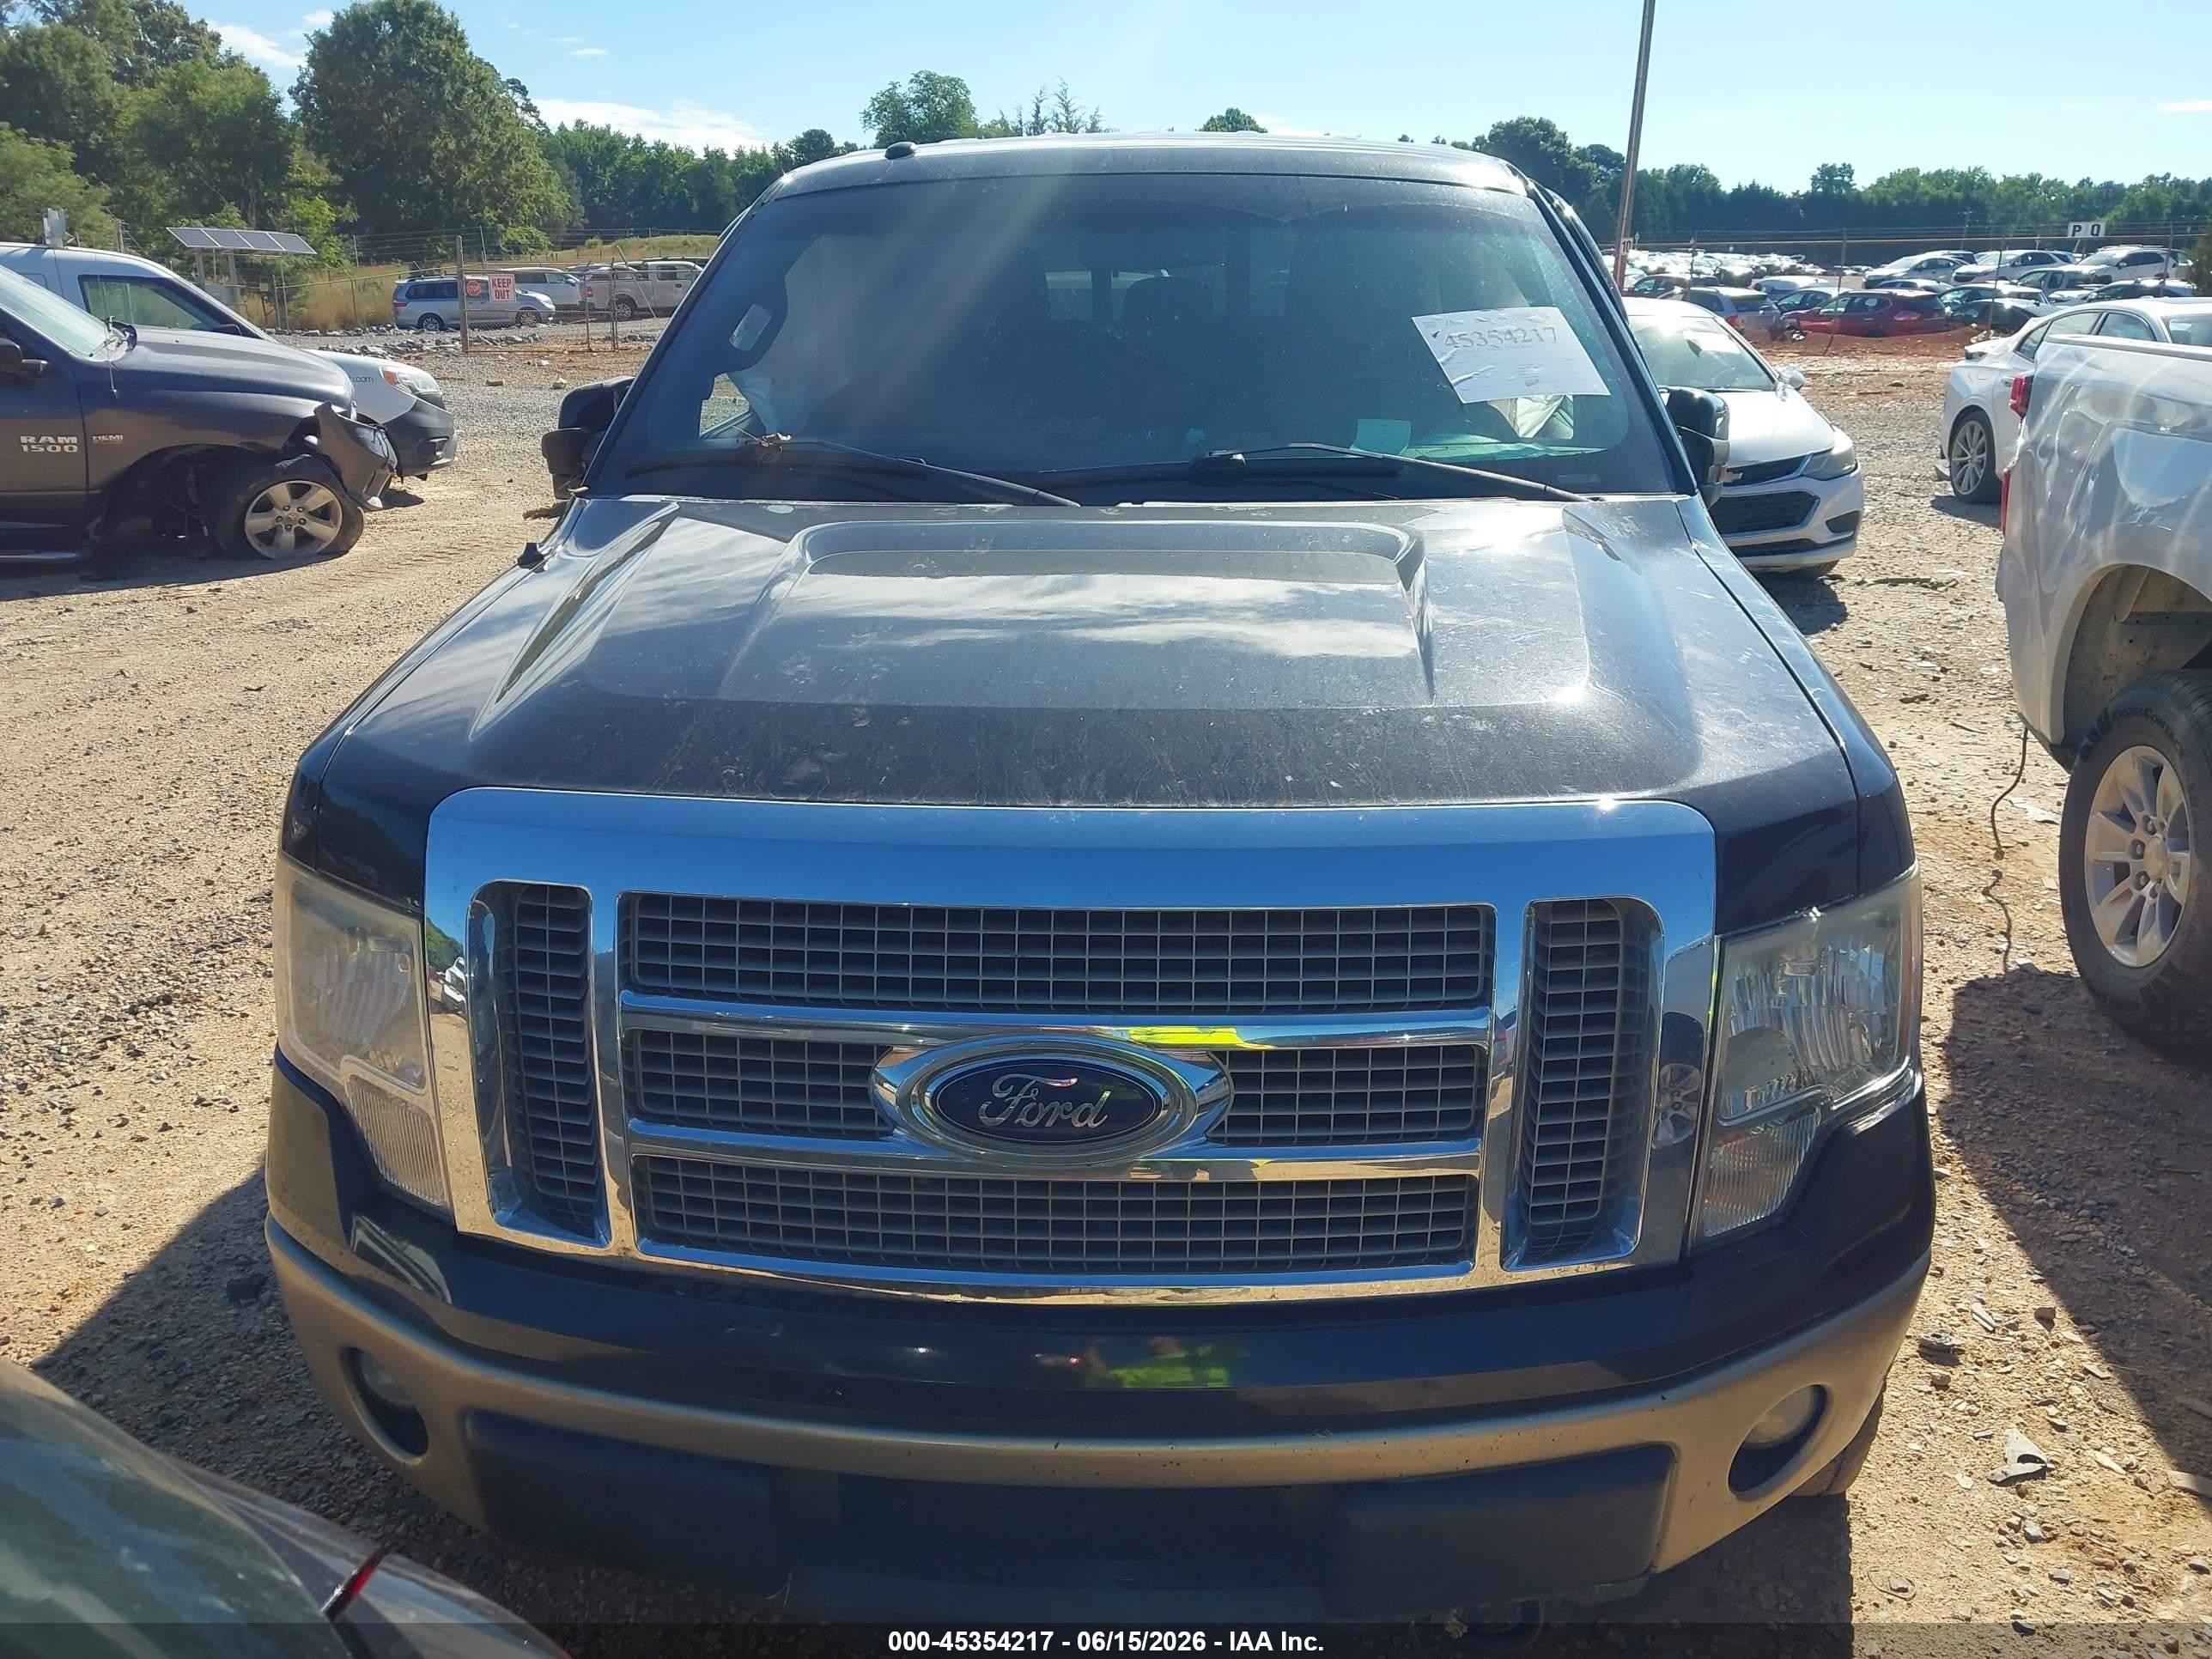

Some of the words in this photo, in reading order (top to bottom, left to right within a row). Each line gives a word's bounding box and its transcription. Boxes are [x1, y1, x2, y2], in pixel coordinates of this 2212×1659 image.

[2071, 224, 2082, 237] P
[2090, 223, 2101, 237] Q
[1622, 240, 1632, 253] 10
[491, 278, 512, 289] KEEP
[495, 289, 510, 300] OUT
[1445, 326, 1558, 348] 45354217
[20, 435, 78, 444] RAM
[978, 1073, 1112, 1128] Ford
